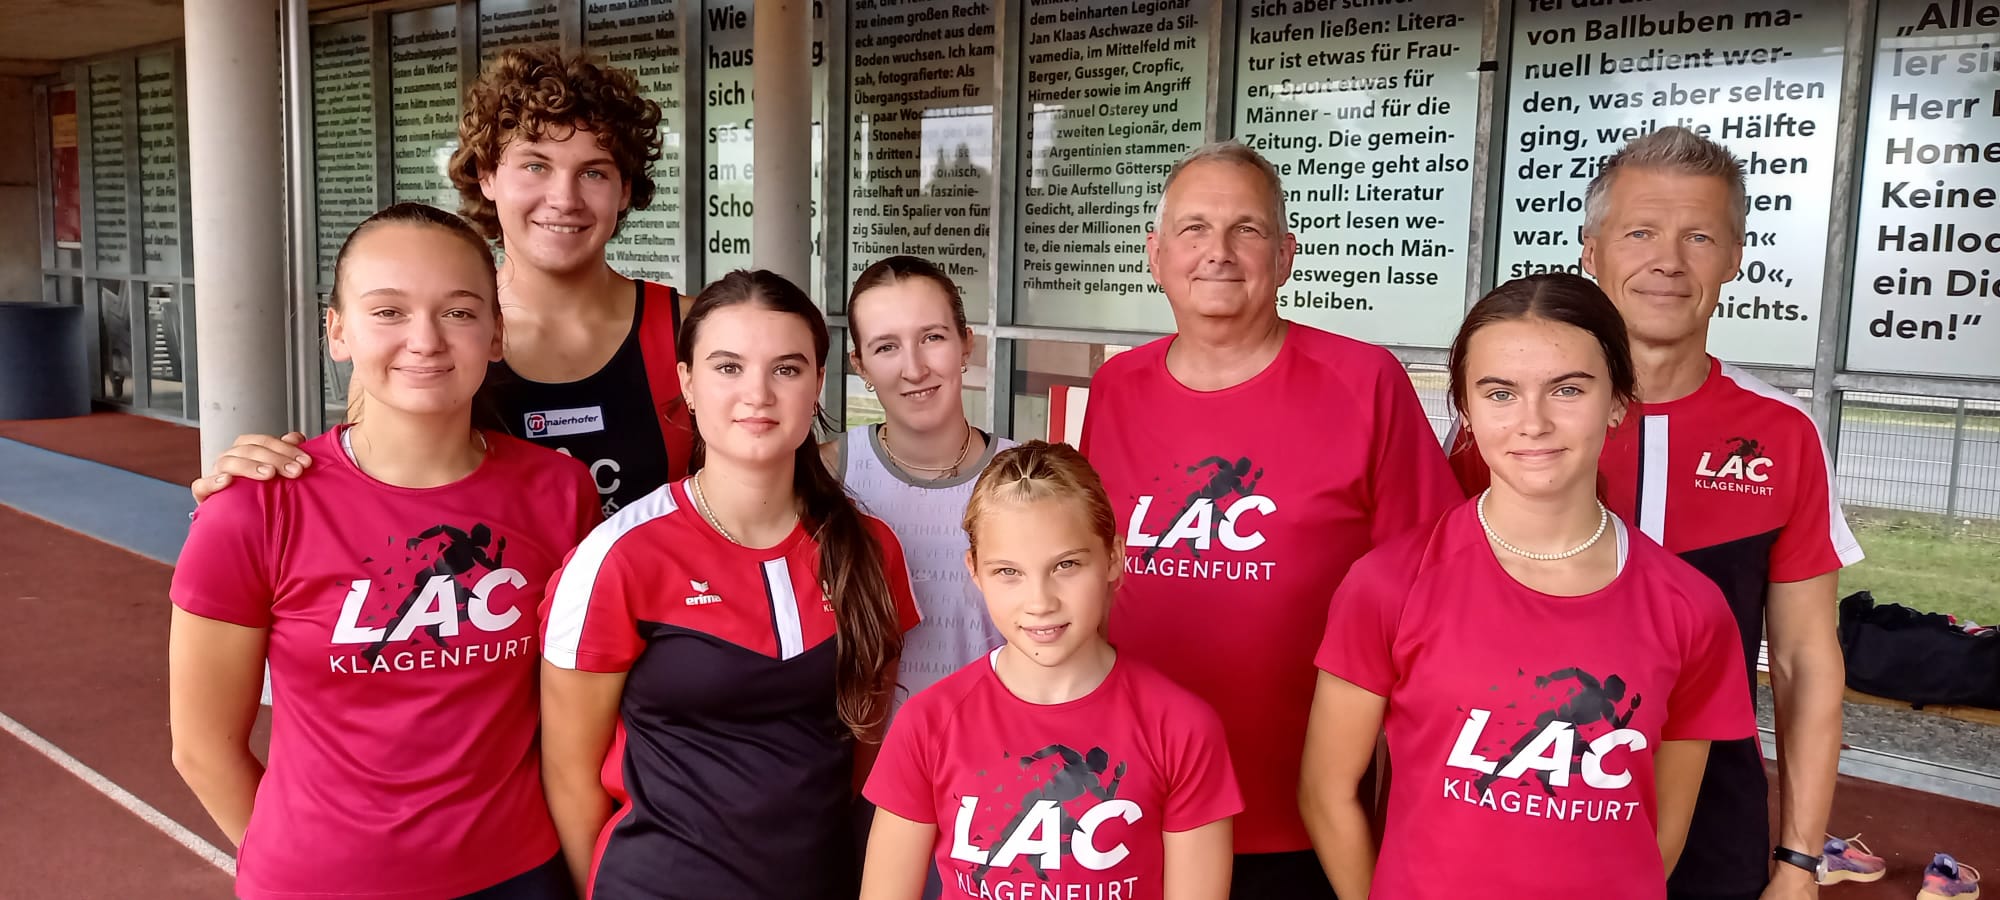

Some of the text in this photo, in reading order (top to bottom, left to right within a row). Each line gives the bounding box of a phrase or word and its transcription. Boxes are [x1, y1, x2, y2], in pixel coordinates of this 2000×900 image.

[588, 3, 608, 14] Aber
[708, 6, 746, 31] Wie
[908, 2, 989, 26] großen Recht-
[1030, 5, 1128, 26] dem beinharten
[1251, 1, 1286, 18] sich
[656, 29, 674, 40] Man
[876, 23, 994, 48] angeordnet aus dem
[1030, 14, 1198, 45] Jan Klaas Aschwaze da Sil-
[1250, 13, 1464, 44] kaufen ließen: Litera-
[1527, 8, 1803, 46] von Ballbuben ma-
[610, 47, 679, 62] keine Fähigkeite
[855, 44, 994, 67] Boden wuchsen. kam
[1029, 36, 1196, 64] vamedia, im Mittelfeld mit
[1249, 42, 1460, 71] tur ist etwas für Frau-
[427, 64, 443, 74] Wort
[1029, 58, 1184, 84] Berger, Gussger, Cropfic,
[1525, 46, 1792, 80] nuell bedient wer-
[1893, 48, 1947, 76] ler
[855, 64, 974, 86] sah, fotografierte: Als
[1404, 69, 1434, 88] für
[654, 82, 672, 92] Man
[708, 81, 744, 106] sich
[854, 84, 980, 106] Übergangsstadium für
[1084, 84, 1120, 98] sowie
[1125, 82, 1140, 95] im
[1144, 76, 1191, 96] Angriff
[1522, 77, 1825, 114] den, was aber selten
[1099, 99, 1178, 118] Osterey und
[1246, 97, 1450, 124] Männer und für die
[1890, 93, 1980, 120] Herr
[874, 112, 898, 125] paar
[1057, 123, 1104, 138] zweiten
[1109, 121, 1167, 138] Legionär,
[1172, 119, 1202, 132] dem
[708, 125, 738, 144] ses
[1246, 126, 1454, 152] Zeitung. Die gemein-
[1520, 113, 1816, 152] ging, Hälfte
[876, 148, 912, 160] dritten
[1049, 144, 1121, 160] Argentinien
[1126, 142, 1190, 155] stammen-
[708, 163, 736, 180] am
[1052, 164, 1111, 177] Guillermo
[1298, 158, 1366, 179] Menge
[1372, 156, 1420, 178] geht
[1426, 153, 1469, 173] also
[1518, 158, 1562, 180] der
[853, 186, 902, 198] rätselhaft
[1048, 182, 1142, 196] Die Aufstellung
[1307, 184, 1349, 202] null:
[1356, 184, 1444, 202] Literatur
[853, 204, 880, 216] rend.
[883, 204, 899, 216] Ein
[902, 204, 942, 219] Spalier
[1026, 202, 1074, 216] Gedicht,
[1078, 202, 1140, 217] allerdings
[853, 222, 990, 238] zig Säulen, auf denen die
[1024, 222, 1054, 234] eines
[1059, 222, 1079, 234] der
[1082, 222, 1140, 234] Millionen
[1289, 211, 1444, 233] Sport lesen we-
[635, 234, 674, 245] Eiffelturm
[708, 231, 750, 254] dem
[1024, 240, 1110, 254] te, die niemals
[1346, 238, 1454, 258] noch Män-
[1513, 230, 1568, 246] war.
[616, 251, 670, 262] Wahrzeichen
[852, 242, 986, 258] Tribünen lasten würden,
[1024, 260, 1051, 272] Preis
[1055, 260, 1115, 275] gewinnen
[1119, 260, 1142, 273] und
[1387, 266, 1438, 285] lasse
[1510, 258, 1582, 278] stand
[1084, 279, 1142, 294] gelangen
[1873, 268, 1932, 296] ein
[1294, 291, 1373, 311] bleiben.
[1715, 296, 1808, 321] nichts.
[1870, 310, 1982, 340] den!“
[546, 414, 599, 426] maierhofer
[1696, 452, 1774, 482] LAC
[1695, 480, 1774, 496] KLAGENFURT
[1126, 495, 1277, 551] LAC
[1125, 558, 1276, 580] KLAGENFURT
[331, 568, 528, 644] LAC
[686, 593, 722, 606] erima
[330, 636, 532, 674] KLAGENFURT
[1446, 708, 1648, 790] LAC
[1444, 778, 1640, 822] KLAGENFURT
[950, 796, 1143, 871] LAC
[956, 869, 1138, 900] KLAGENFURT
